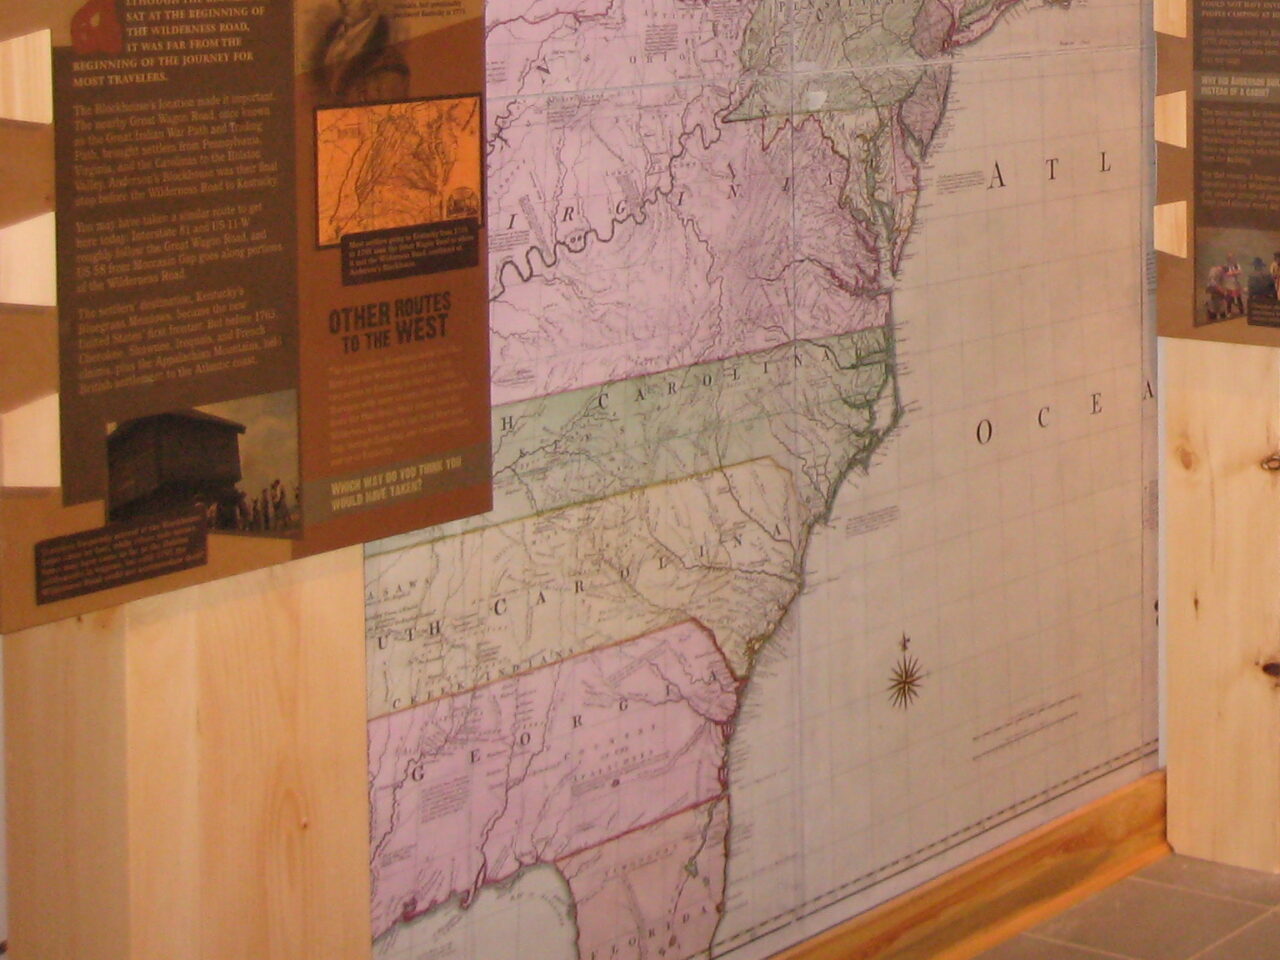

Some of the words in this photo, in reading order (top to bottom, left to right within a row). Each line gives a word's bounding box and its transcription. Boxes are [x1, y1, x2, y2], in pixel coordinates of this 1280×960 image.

[126, 12, 145, 23] SAT
[147, 11, 162, 22] AT
[188, 6, 249, 19] BEGINNING
[151, 23, 217, 36] WILDERNESS
[141, 40, 165, 52] WAS
[166, 40, 187, 51] FAR
[189, 38, 221, 50] FROM
[72, 59, 138, 73] BEGINNING
[181, 53, 231, 68] JOURNEY
[72, 75, 106, 89] MOST
[328, 301, 391, 335] OTHER
[394, 290, 452, 318] ROUTES
[342, 334, 361, 355] TO
[364, 329, 391, 350] THE
[396, 312, 449, 345] WEST
